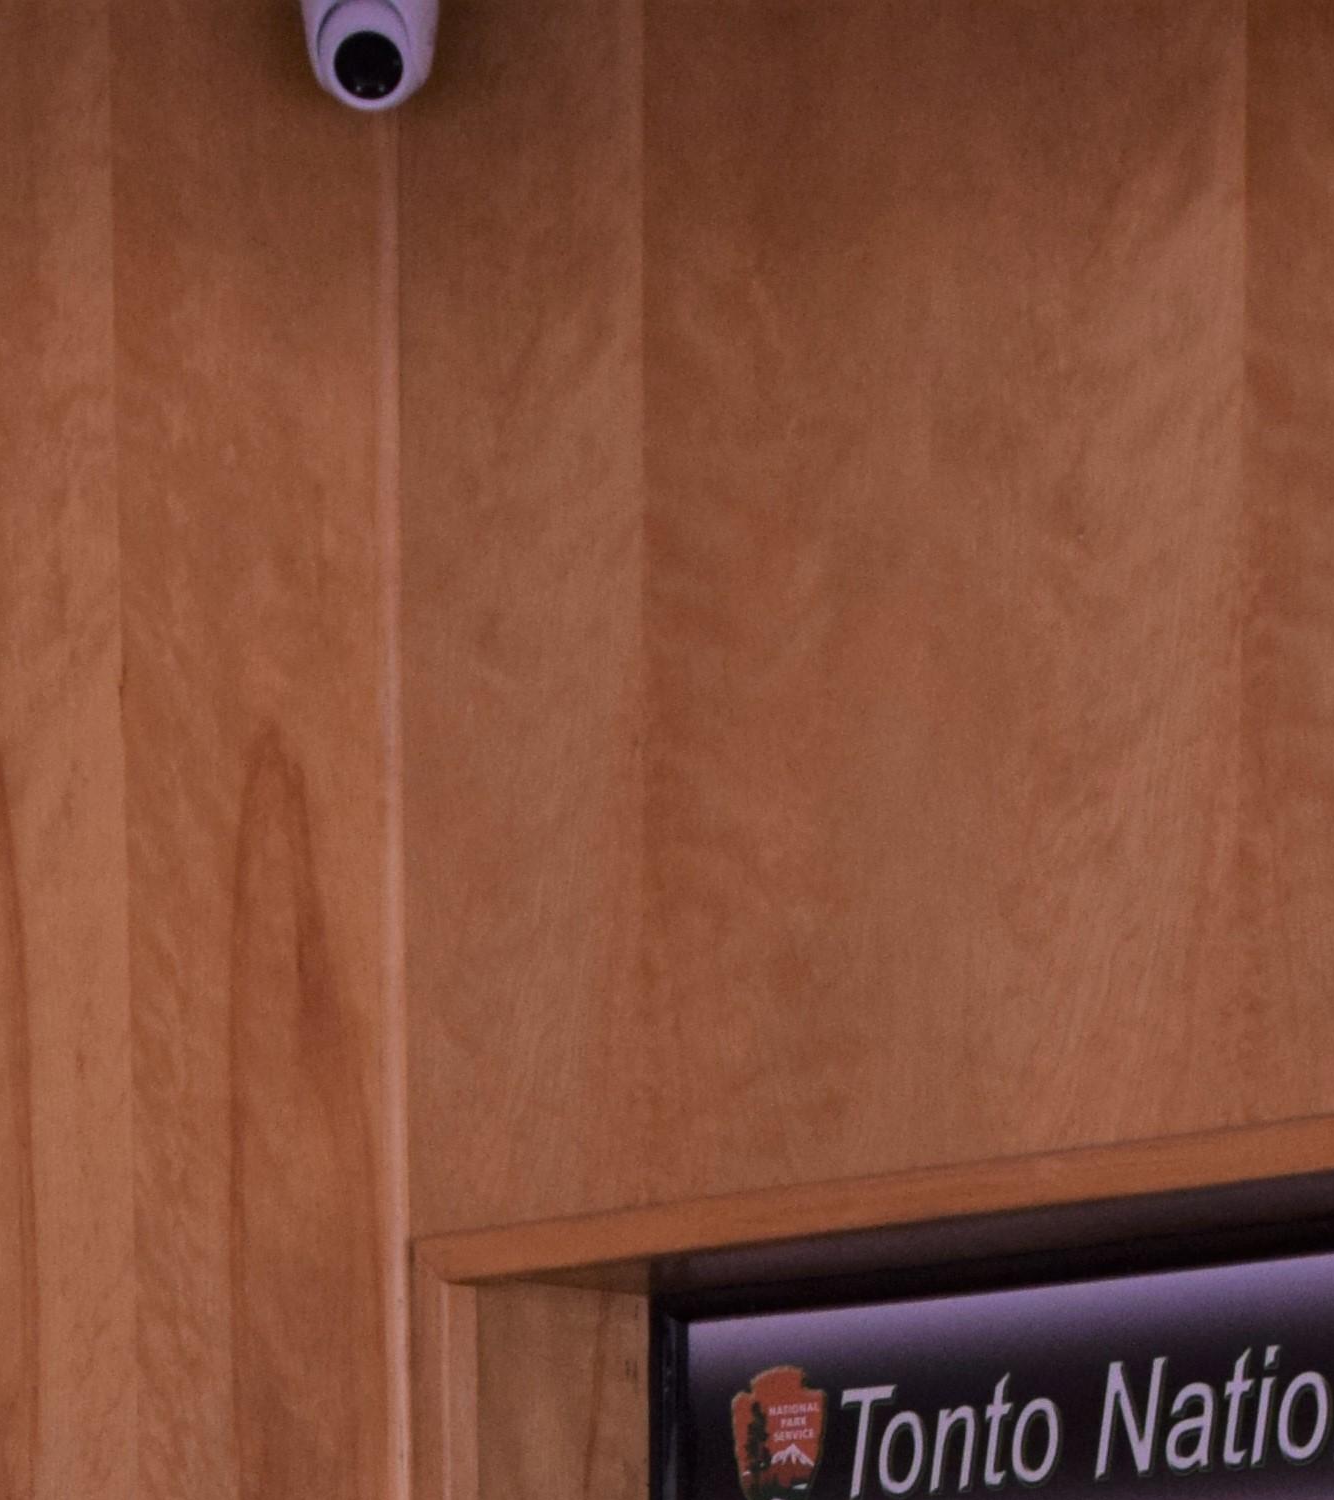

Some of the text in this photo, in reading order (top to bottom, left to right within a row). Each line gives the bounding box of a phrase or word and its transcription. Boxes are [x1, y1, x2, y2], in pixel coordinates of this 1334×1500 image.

[768, 1401, 820, 1417] NATIONAL
[780, 1416, 807, 1429] PARK
[773, 1428, 815, 1443] SERVICE
[841, 1370, 1061, 1500] Tonto
